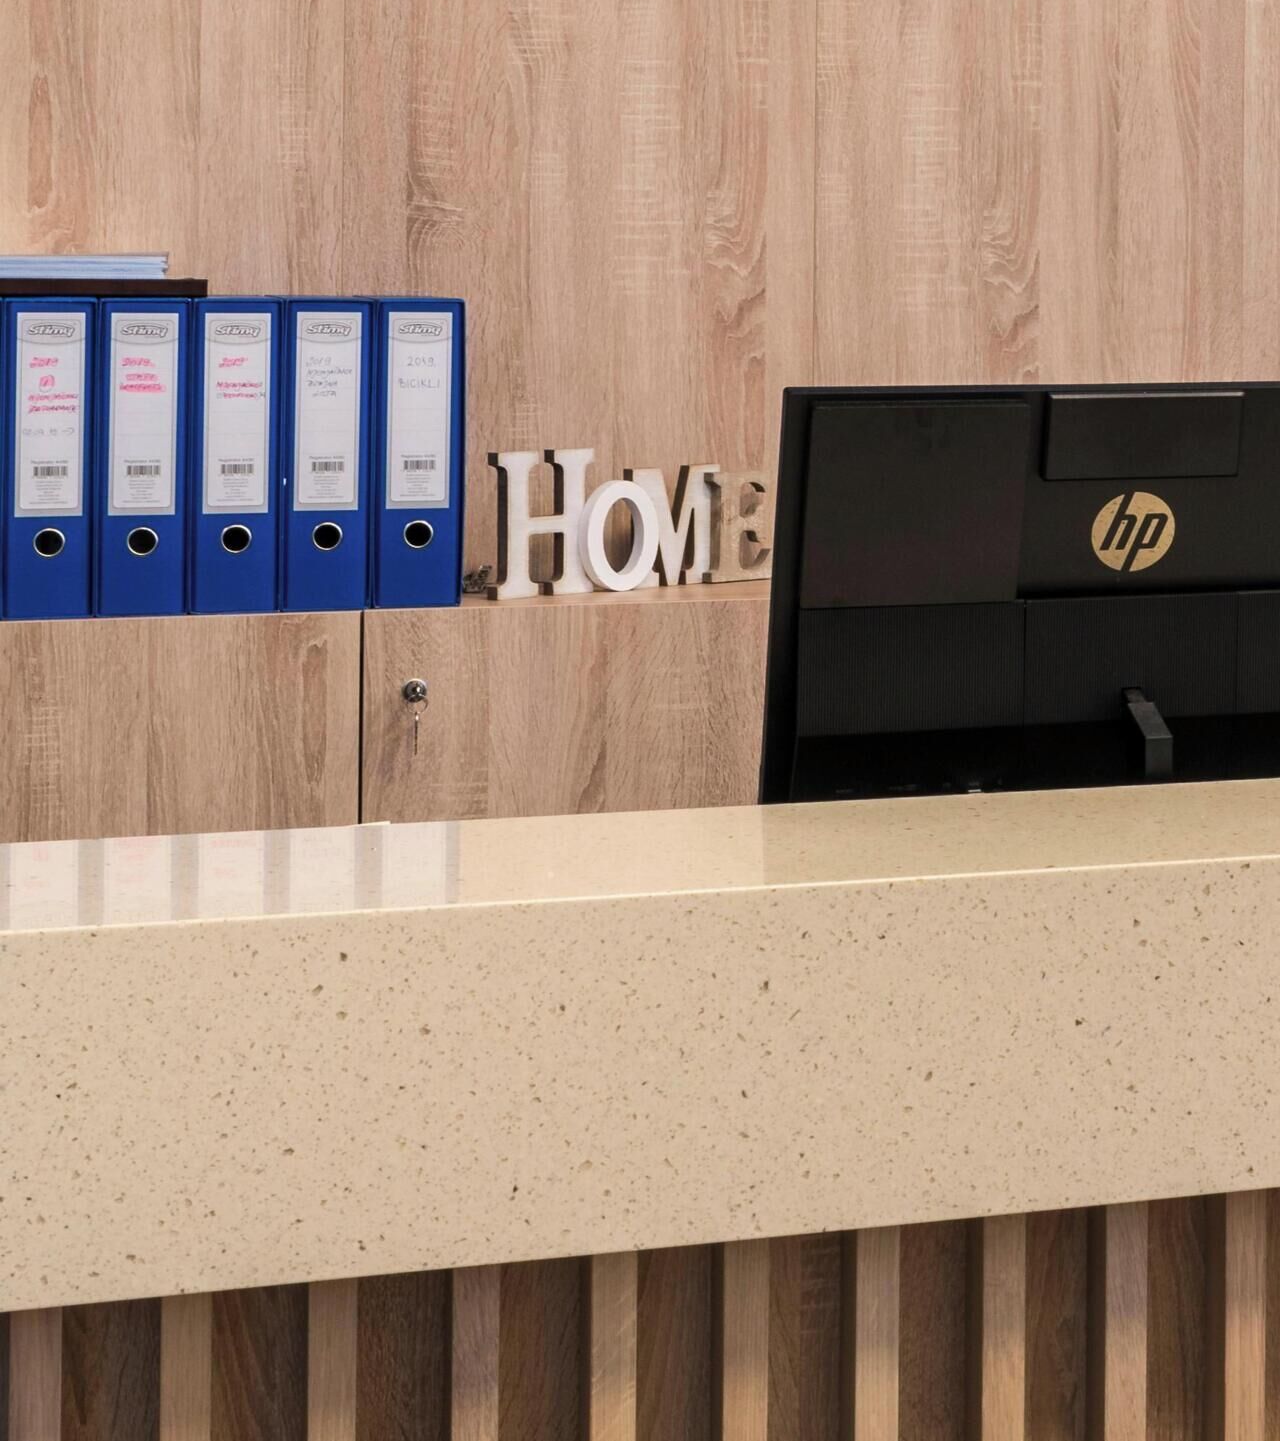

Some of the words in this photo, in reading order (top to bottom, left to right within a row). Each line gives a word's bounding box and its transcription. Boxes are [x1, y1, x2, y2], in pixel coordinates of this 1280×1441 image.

[28, 324, 75, 338] Stimy
[121, 324, 168, 338] Stimy
[215, 324, 261, 338] Stimy
[305, 323, 352, 337] Stimy
[398, 323, 443, 337] Stimy
[487, 447, 774, 601] HOME
[1099, 491, 1169, 572] hp
